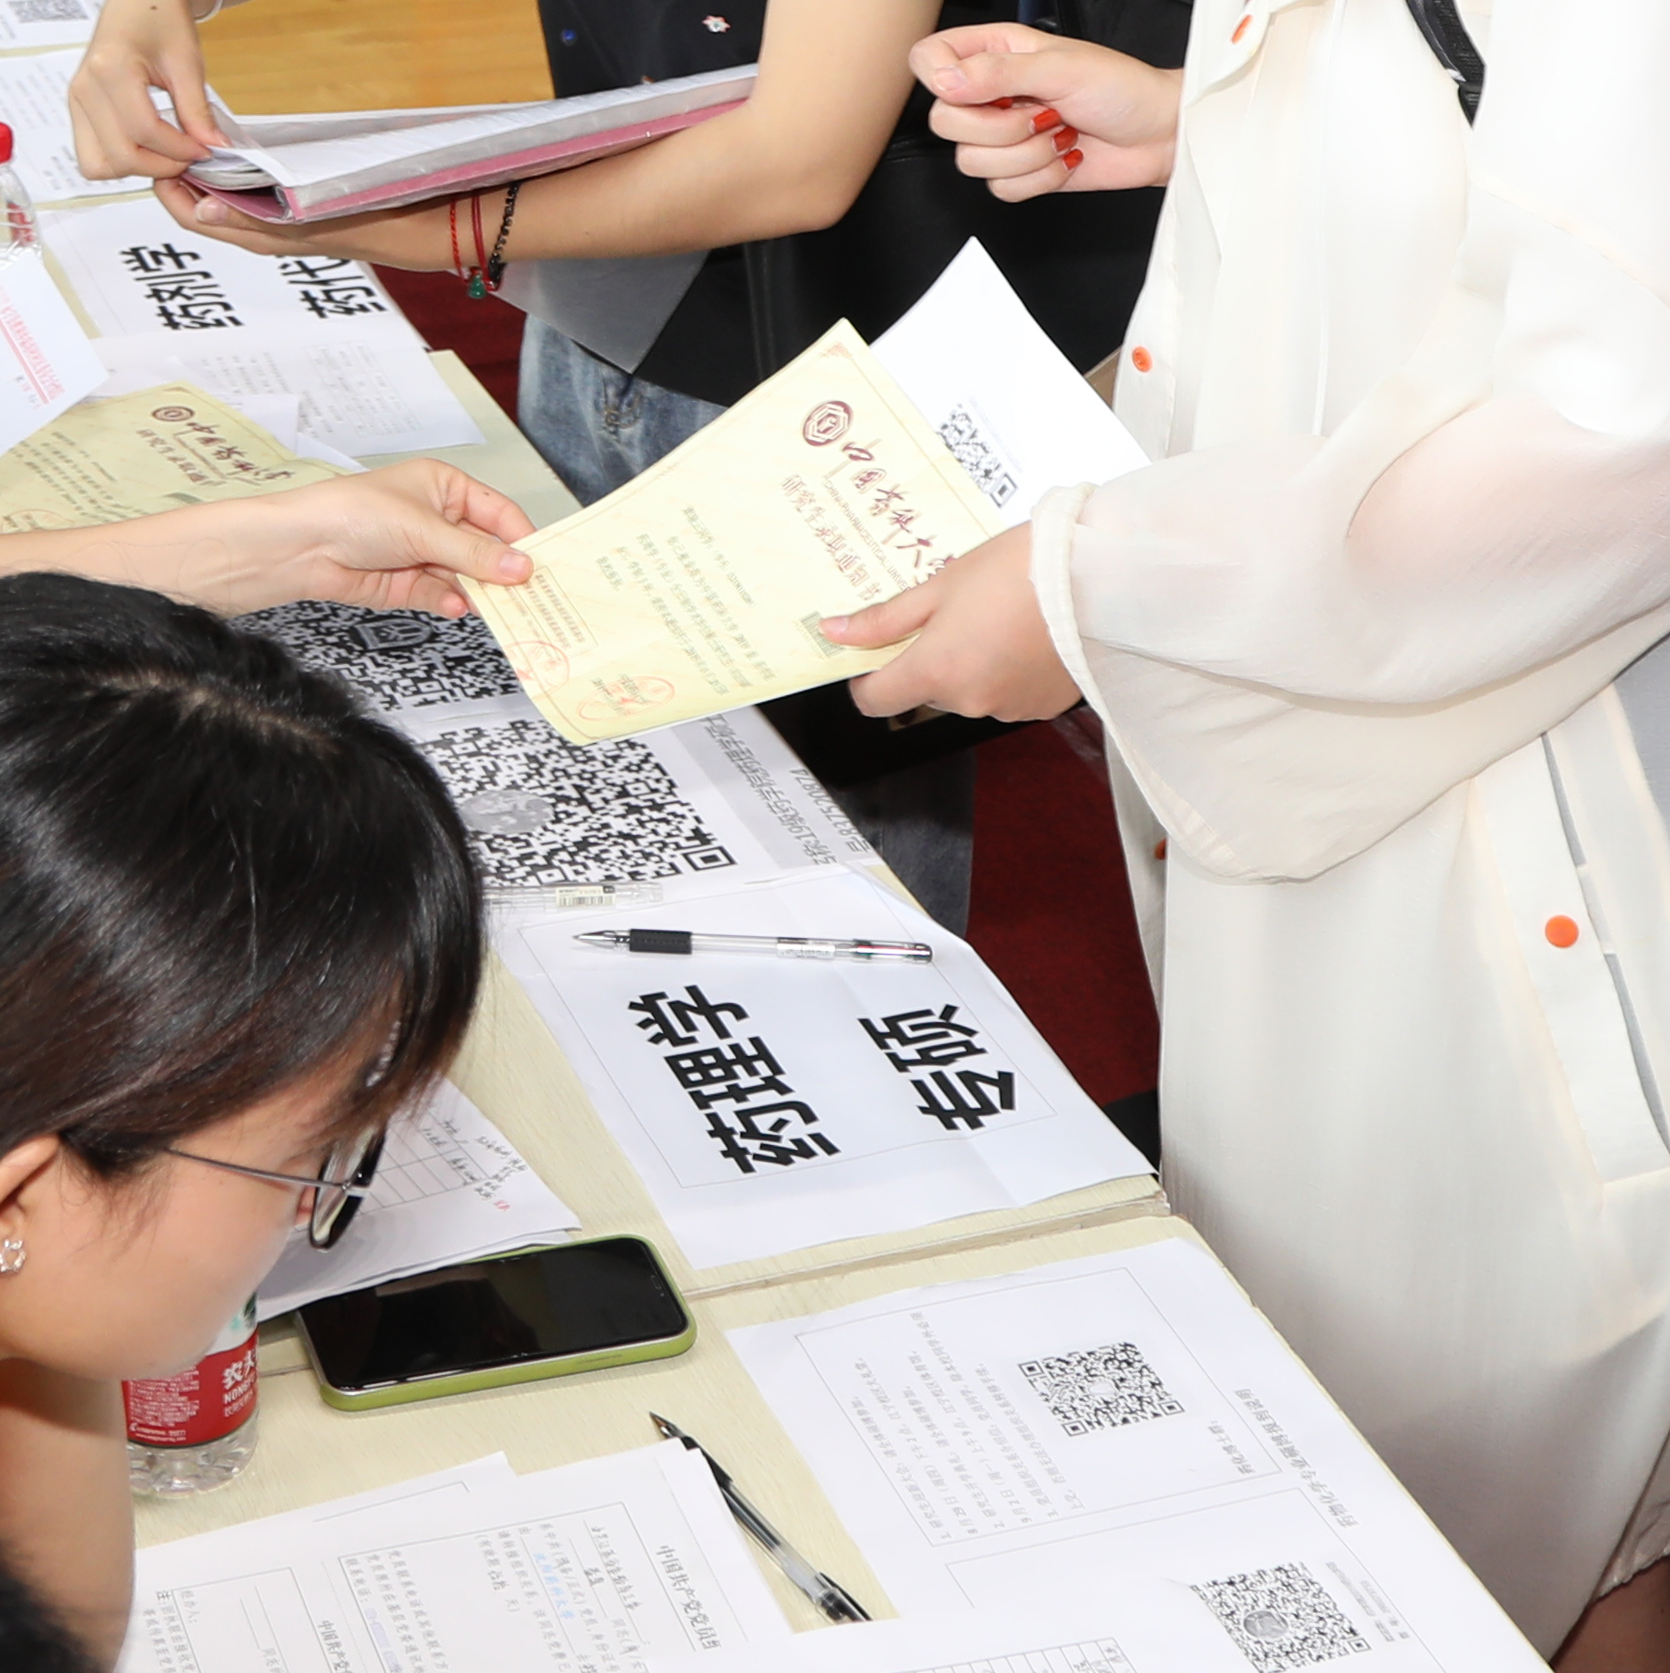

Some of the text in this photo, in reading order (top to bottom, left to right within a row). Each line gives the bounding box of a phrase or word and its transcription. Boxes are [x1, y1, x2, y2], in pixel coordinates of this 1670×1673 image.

[119, 243, 245, 330] 药剂学
[782, 475, 881, 601] 研究生录取通知书
[628, 984, 841, 1174] 药理学
[858, 1003, 1017, 1132] 专硕
